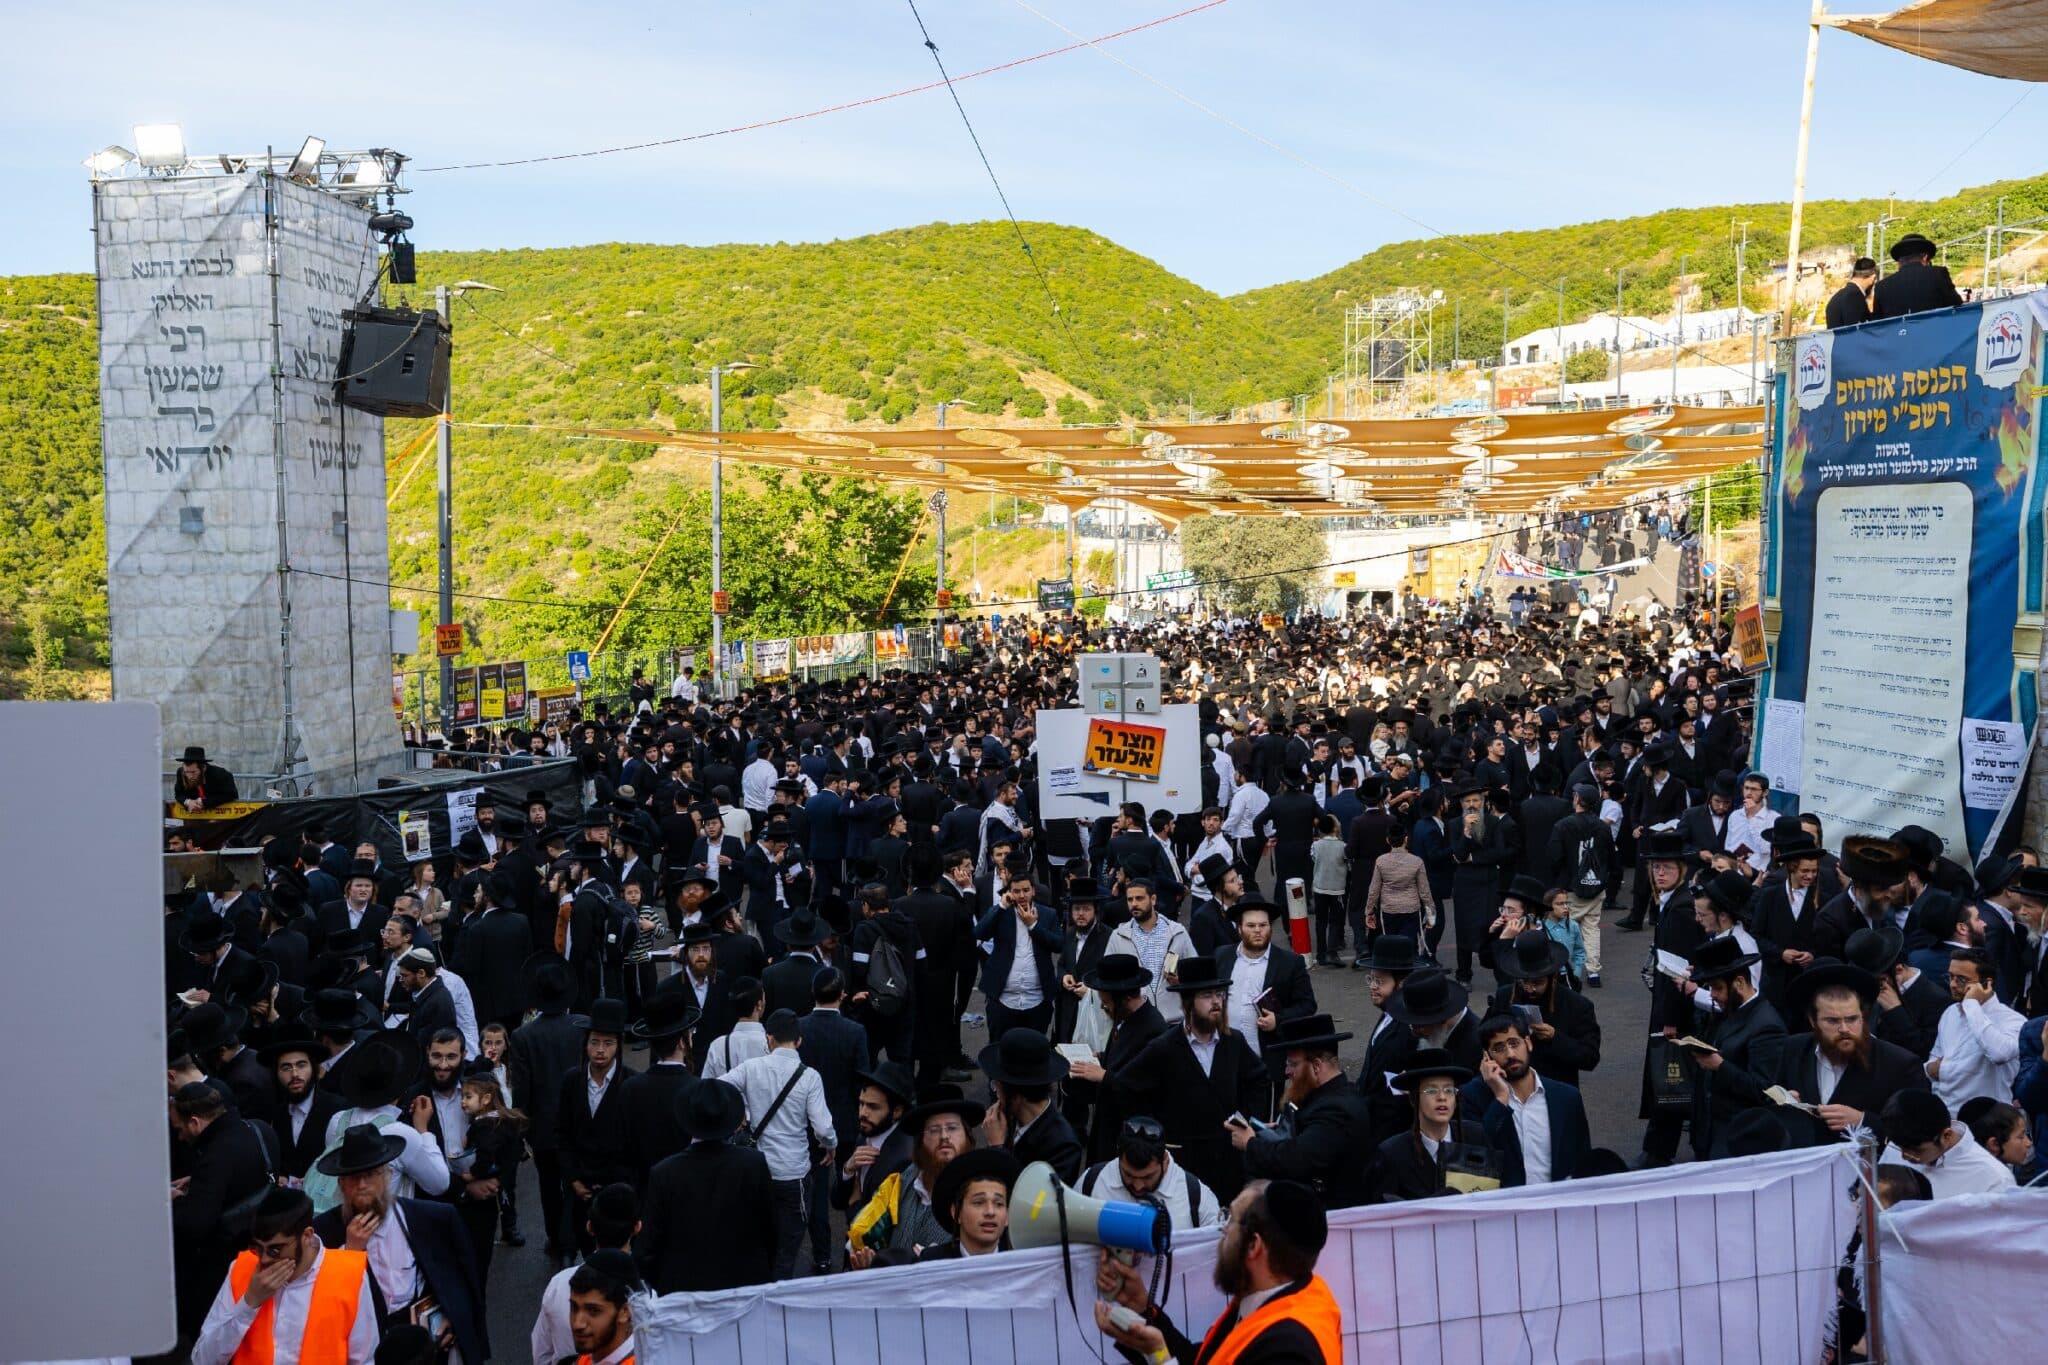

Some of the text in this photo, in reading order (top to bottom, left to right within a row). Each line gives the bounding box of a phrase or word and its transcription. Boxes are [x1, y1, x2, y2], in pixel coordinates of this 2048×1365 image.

[131, 248, 234, 279] לכבוד התנא
[303, 266, 357, 298] עולו ואתו
[151, 285, 213, 321] האלוקי
[160, 323, 205, 353] רבי
[144, 364, 224, 403] שמעון
[1836, 364, 1968, 406] הכנסת אורחים
[157, 403, 216, 433] בר
[1844, 400, 1951, 443] רשב"י מירון
[146, 443, 232, 473] יוחאי
[309, 437, 362, 479] שמעון
[1845, 463, 1866, 478] מאיר
[1867, 461, 1888, 477] והרב
[1930, 457, 1954, 477] יעקב
[1956, 456, 1978, 472] הרב
[1097, 724, 1156, 750] חצר ר'
[1095, 746, 1154, 769] אלעזר
[1975, 757, 2020, 769] חיים שלום
[1971, 771, 2016, 783] סתר מלכה
